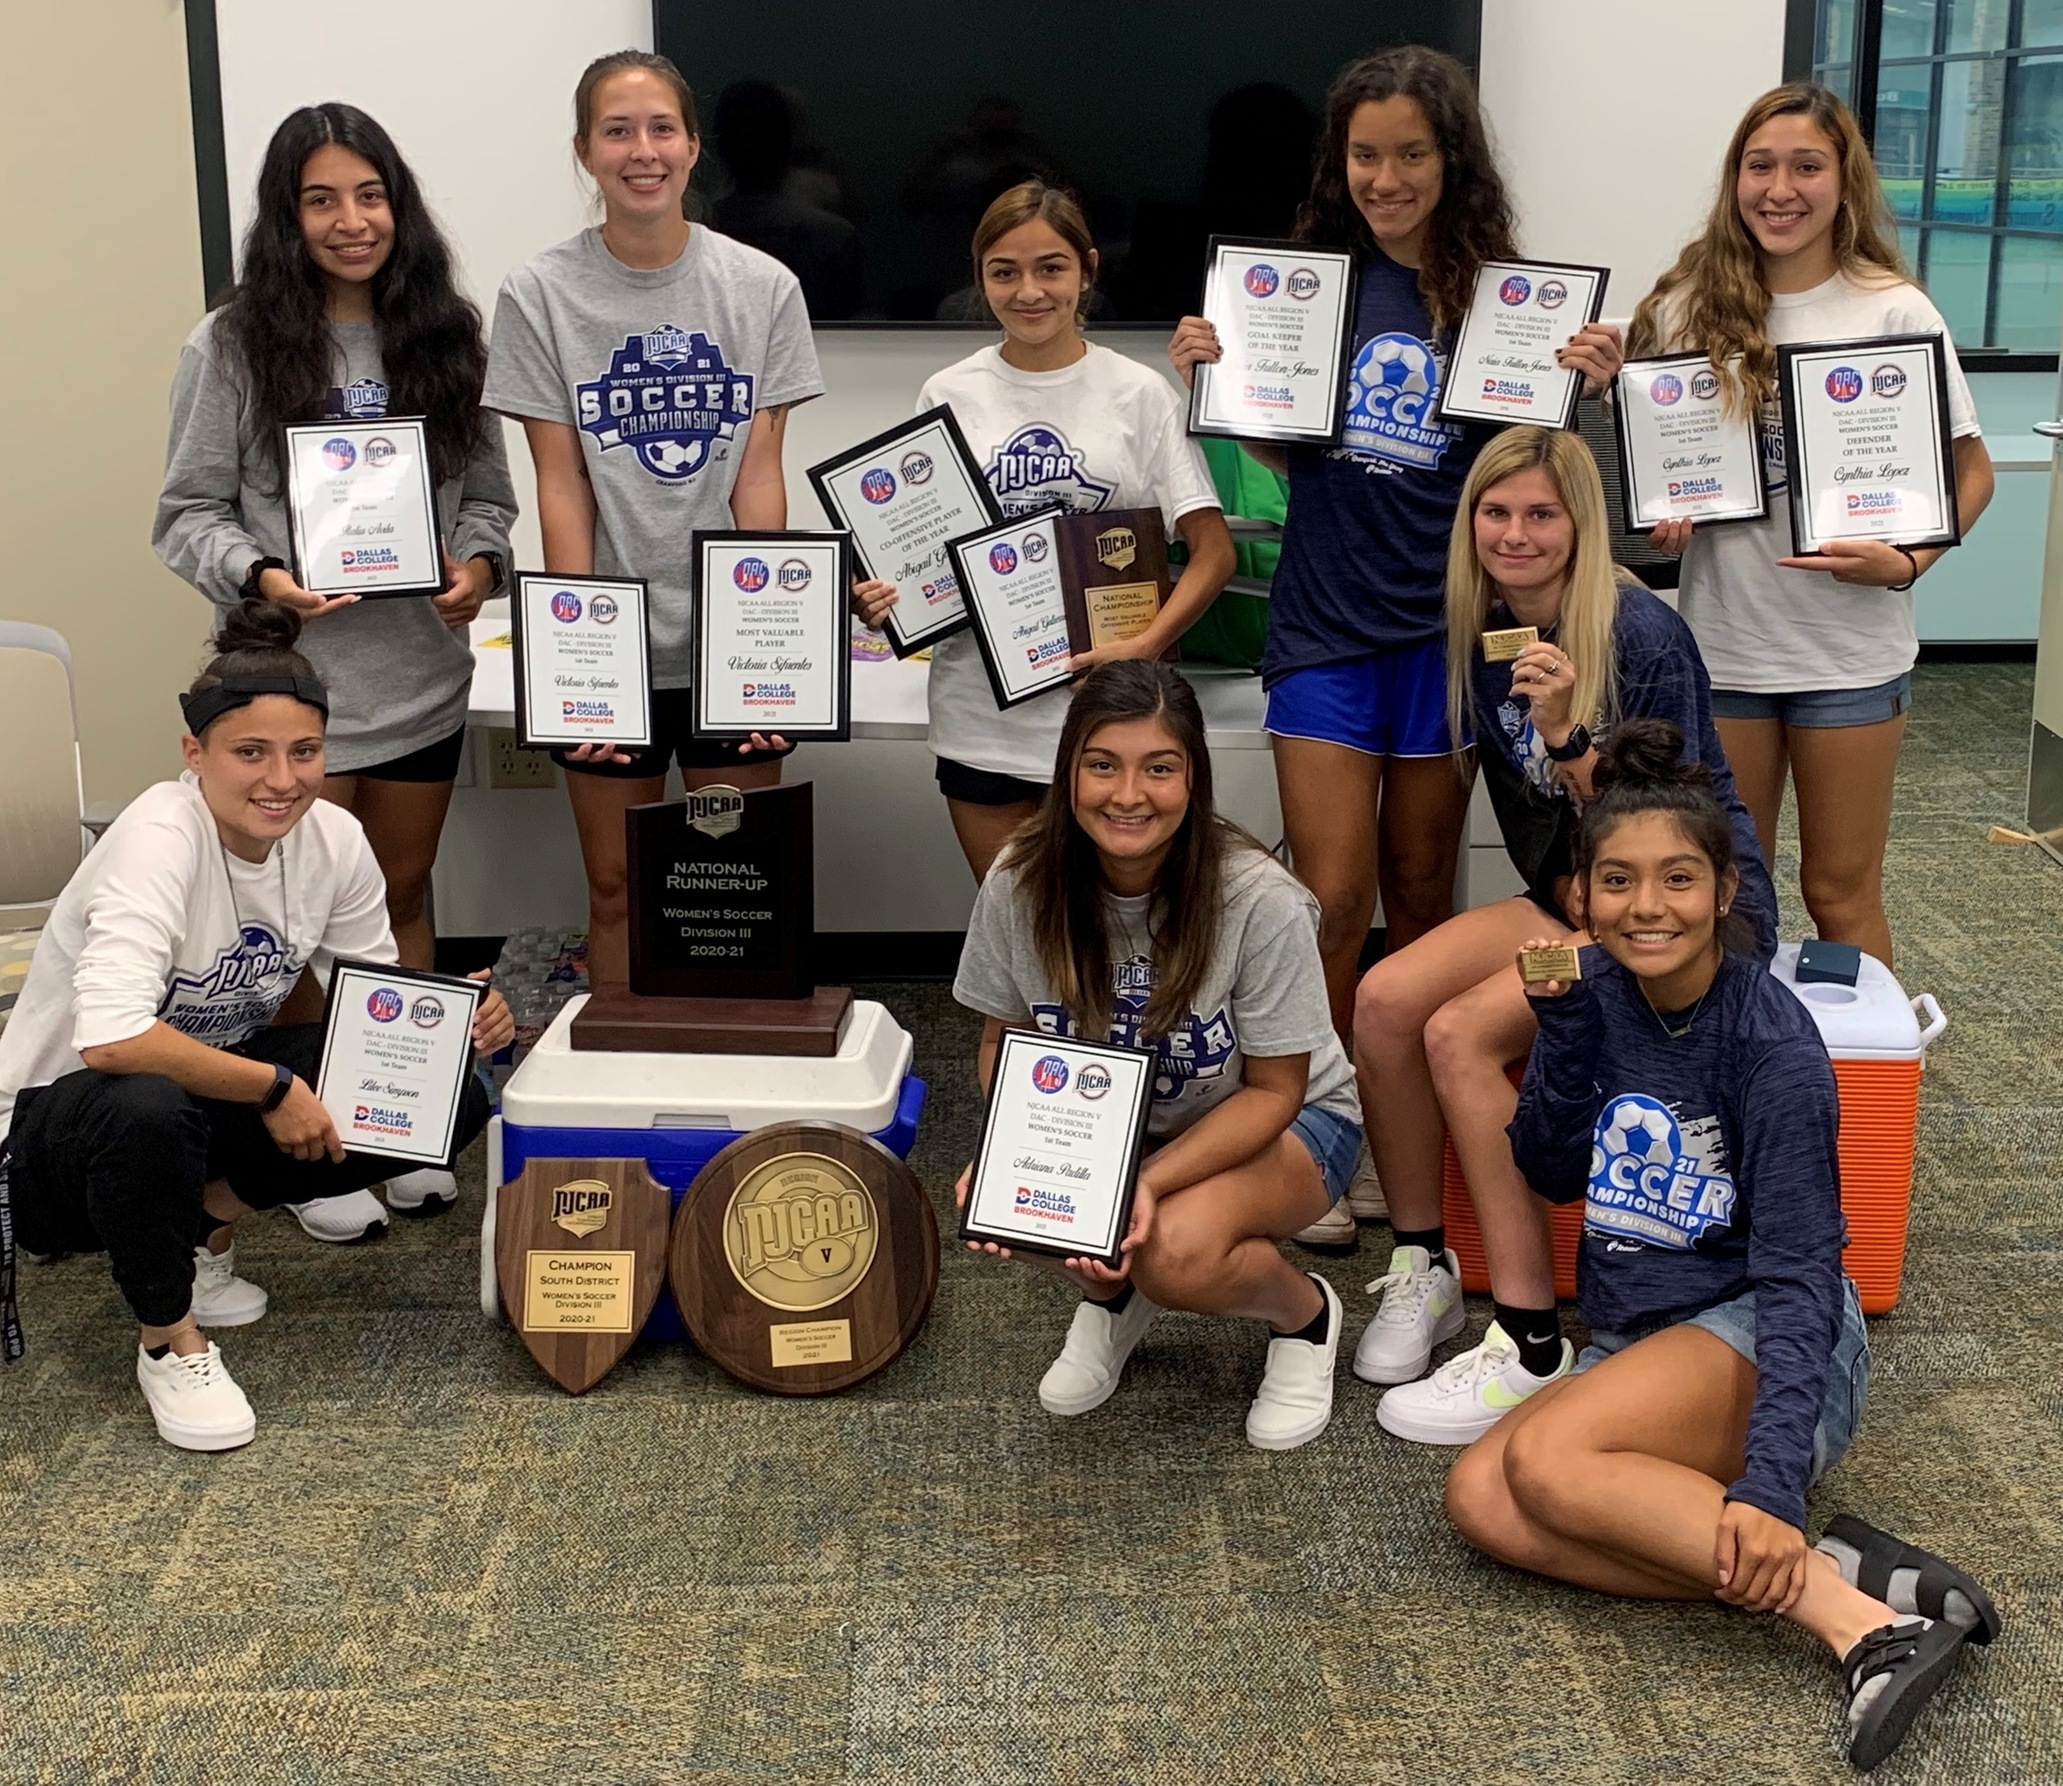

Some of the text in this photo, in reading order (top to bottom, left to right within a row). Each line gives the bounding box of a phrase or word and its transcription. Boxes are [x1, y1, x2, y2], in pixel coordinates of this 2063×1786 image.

[1247, 331, 1302, 341] GOAL KEEPER
[644, 334, 686, 356] NJCAA
[623, 359, 711, 372] 20 21
[1254, 359, 1319, 378] Fulton-Jones
[610, 374, 726, 387] WOMEN'S DIVISION III
[1499, 380, 1530, 390] DALLAS
[1872, 374, 1907, 392] NJCAA
[1257, 386, 1289, 394] DALLAS
[1497, 388, 1534, 398] COLLEGE
[346, 387, 388, 410] NJCAA
[580, 382, 749, 426] SOCCER
[1256, 393, 1294, 402] COLLEGE
[1482, 394, 1532, 405] BROOKHAVEN
[621, 410, 719, 437] CHAMPIONSHIP
[1345, 413, 1446, 446] AMPIONSHIP
[1839, 426, 1871, 434] WOMEN'S
[1660, 429, 1691, 437] WOMEN'S
[1847, 435, 1892, 446] DEFENDER
[1375, 440, 1416, 455] DIVISION
[1417, 451, 1428, 459] III
[1842, 448, 1855, 457] OF
[1875, 446, 1897, 454] YEAR
[1663, 453, 1721, 472] Cynthia Lopez
[1000, 454, 1071, 493] NJCAA
[1834, 463, 1910, 485] Cynthia Lopez
[1683, 477, 1716, 488] DALLAS
[1683, 484, 1723, 495] COLLEGE
[1063, 491, 1072, 499] III
[1670, 493, 1723, 504] BROOKHAVEN
[1862, 491, 1895, 500] DALLAS
[880, 507, 962, 551] CO-OFFENSIVE PLAYER
[901, 525, 949, 552] OF THE YEAR
[357, 548, 391, 557] DALLAS
[1098, 536, 1135, 558] NJCAA
[357, 555, 398, 564] COLLEGE
[343, 564, 399, 573] BROOKHAVEN
[895, 553, 931, 582] Abigail
[778, 569, 812, 585] NJCAA
[1103, 593, 1142, 602] NATIONAL
[590, 603, 618, 617] NJCAA
[1094, 600, 1153, 612] CHAMPIONSHIP
[1038, 636, 1066, 652] DALLAS
[727, 656, 812, 675] Victoria Sifuentes
[554, 675, 585, 687] Victoria
[757, 690, 796, 698] COLLEGE
[577, 701, 608, 709] DALLAS
[576, 709, 614, 717] COLLEGE
[688, 796, 744, 821] NJCAA
[674, 862, 761, 875] NATIONAL
[666, 875, 768, 890] RUNNER-UP
[662, 908, 772, 920] WOMEN'S SOCCER
[681, 927, 751, 938] DIVISION III
[690, 946, 744, 956] 2020-21
[174, 1002, 241, 1013] WOMEN'S
[410, 1004, 445, 1020] NJCAA
[364, 1049, 427, 1064] WOMEN'S SOCCER
[1075, 1073, 1111, 1090] NJCAA
[382, 1081, 420, 1099] Simpson
[372, 1107, 408, 1119] DALLAS
[1027, 1102, 1050, 1111] NJCAA
[1052, 1106, 1065, 1114] ALL
[1066, 1108, 1094, 1119] REGION
[353, 1122, 411, 1136] BROOKHAVEN
[370, 1116, 413, 1129] COLLEGE
[1028, 1123, 1092, 1140] WOMEN'S SOCCER
[1055, 1138, 1071, 1147] Team
[1013, 1156, 1091, 1180] Adriana Padilla
[1674, 1157, 1696, 1174] 21
[780, 1173, 820, 1188] REGION
[1589, 1144, 1732, 1219] OCCER
[1, 1184, 9, 1204] AND
[1034, 1190, 1071, 1204] DALLAS
[554, 1190, 610, 1218] NJCAA
[1032, 1199, 1076, 1214] COLLEGE
[1587, 1183, 1700, 1229] AMPIONSHIP
[1014, 1206, 1074, 1223] BROOKHAVEN
[1, 1207, 13, 1249] PROTECT
[1585, 1203, 1617, 1222] MEN'S
[1621, 1216, 1668, 1237] DIVISION
[1670, 1231, 1681, 1242] III
[744, 1194, 866, 1271] NJCAA
[820, 1248, 832, 1263] V
[549, 1260, 612, 1271] CHAMPION
[540, 1276, 620, 1286] SOUTH DISTRICT
[542, 1292, 616, 1300] WOMEN'S SOCCER
[555, 1301, 602, 1309] DIVISION III
[560, 1315, 595, 1323] 2020-21
